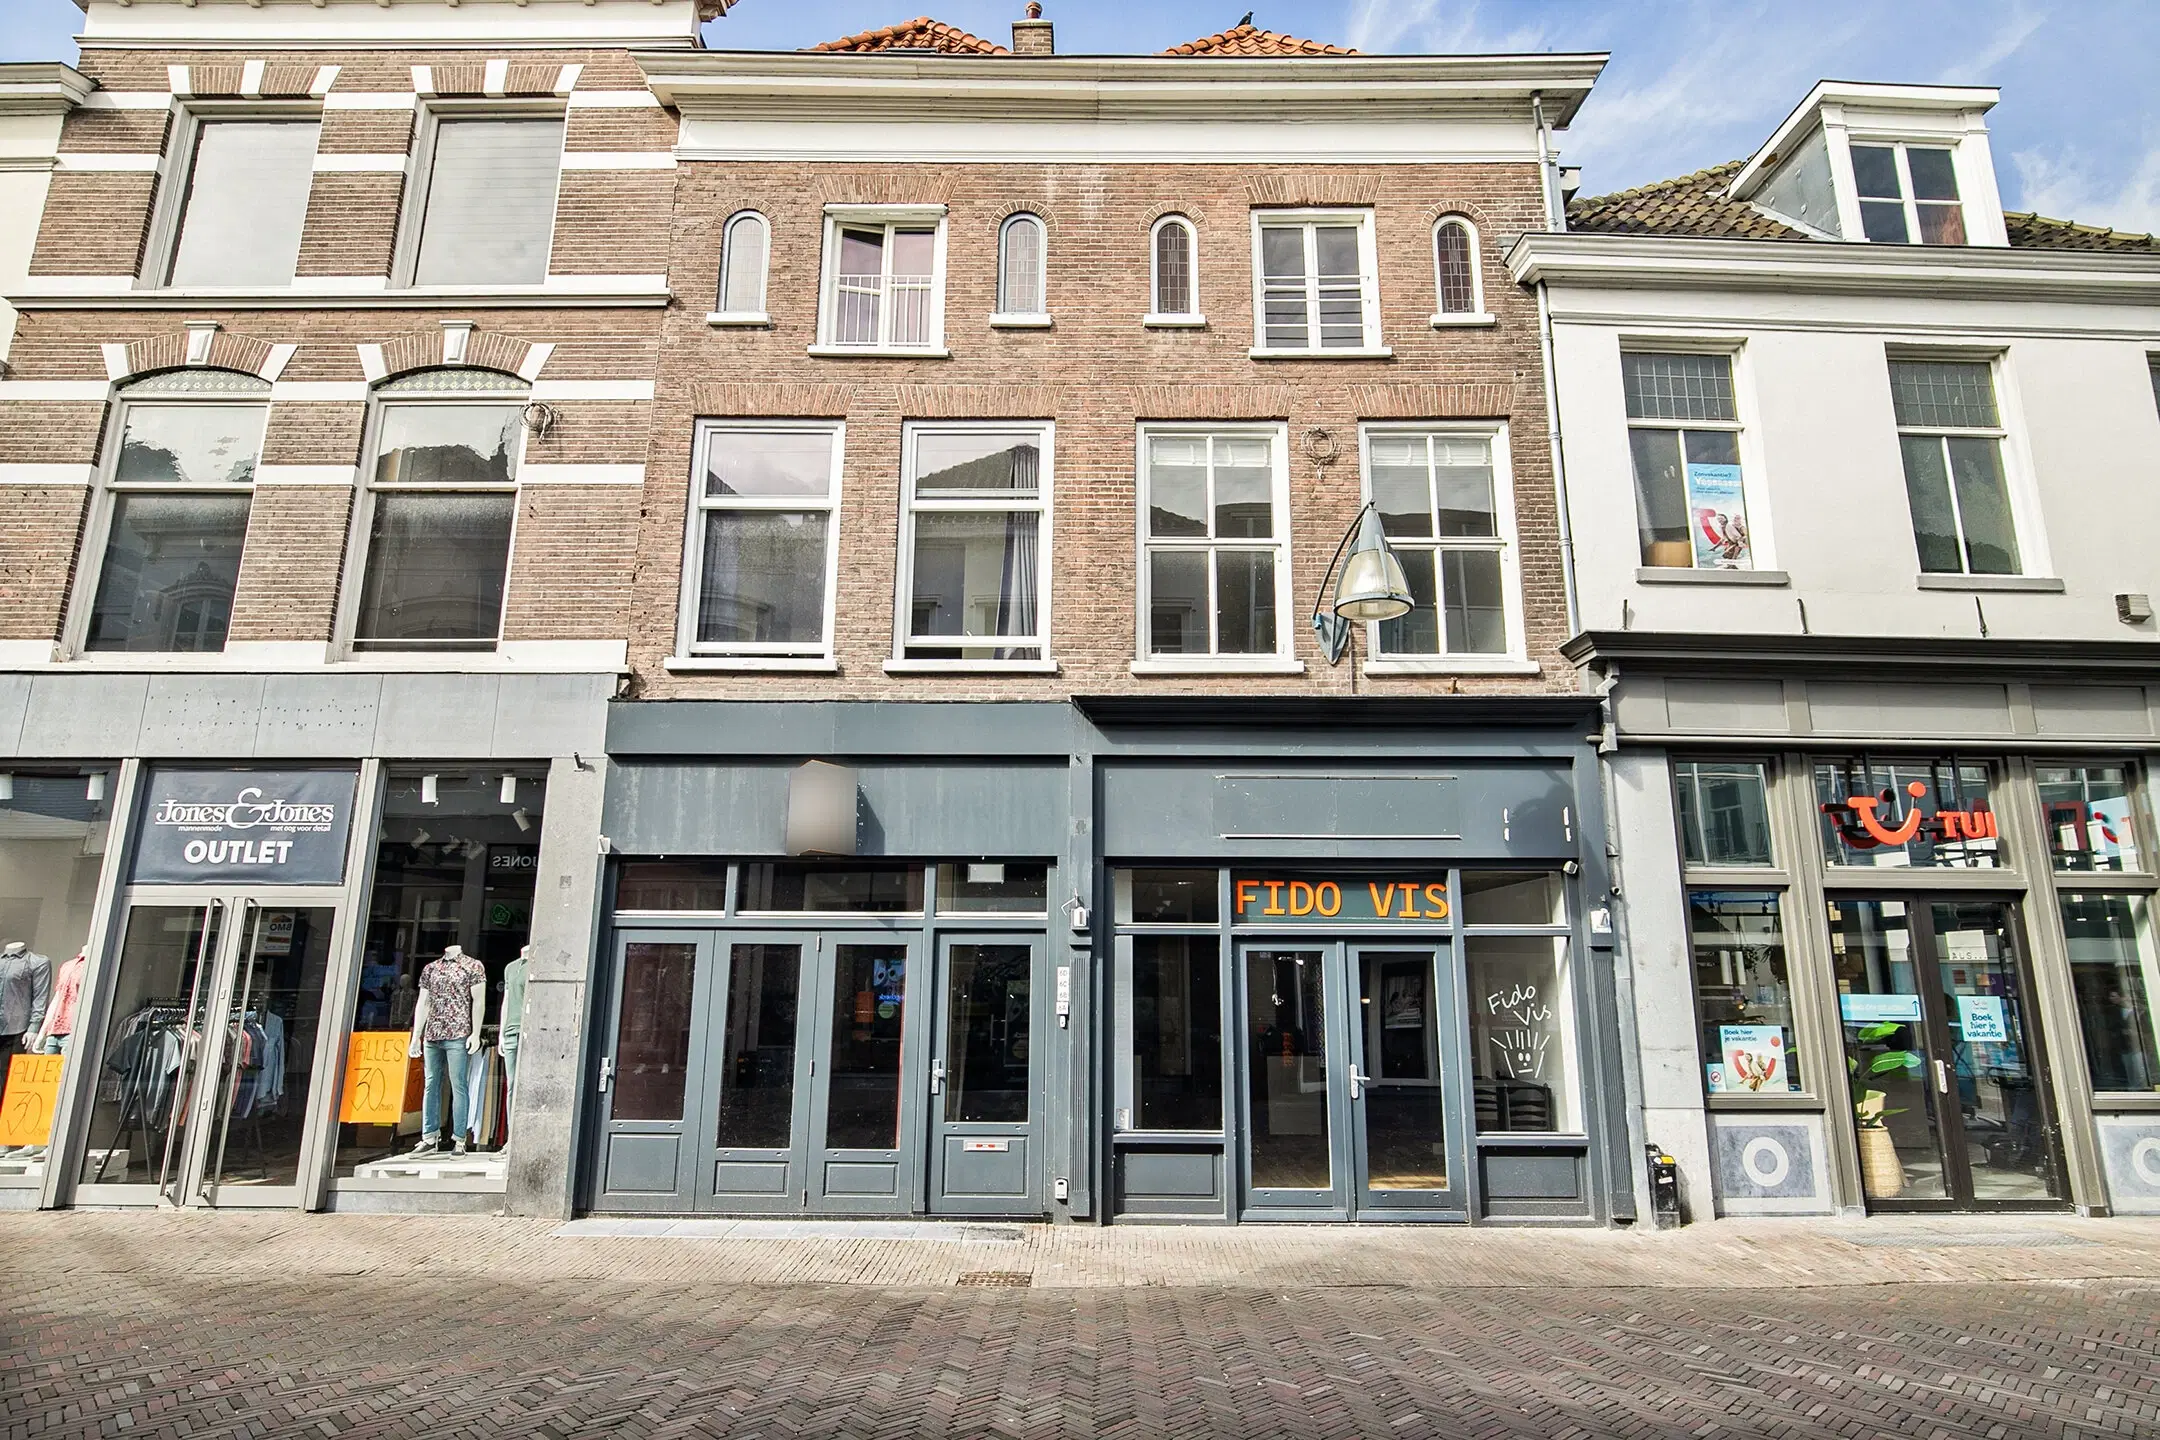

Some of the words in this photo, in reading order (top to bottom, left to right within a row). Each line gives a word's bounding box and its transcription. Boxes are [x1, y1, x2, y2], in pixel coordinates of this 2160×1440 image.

[155, 800, 226, 824] Jones
[226, 787, 264, 829] &
[264, 800, 334, 823] Jones
[312, 824, 331, 832] detail
[1936, 810, 1999, 840] TUI
[183, 839, 294, 865] OUTLET
[1236, 880, 1342, 916] FIDO
[1368, 882, 1449, 919] VIS
[1487, 983, 1536, 1015] Fido
[1513, 1002, 1552, 1026] Vis
[1970, 1021, 1987, 1029] hier
[1988, 1021, 1997, 1031] je
[1971, 1013, 1993, 1021] Boek
[1966, 1030, 2002, 1038] vakantie
[353, 1038, 405, 1063] ALLES
[350, 1067, 386, 1112] 30
[6, 1090, 43, 1136] 30
